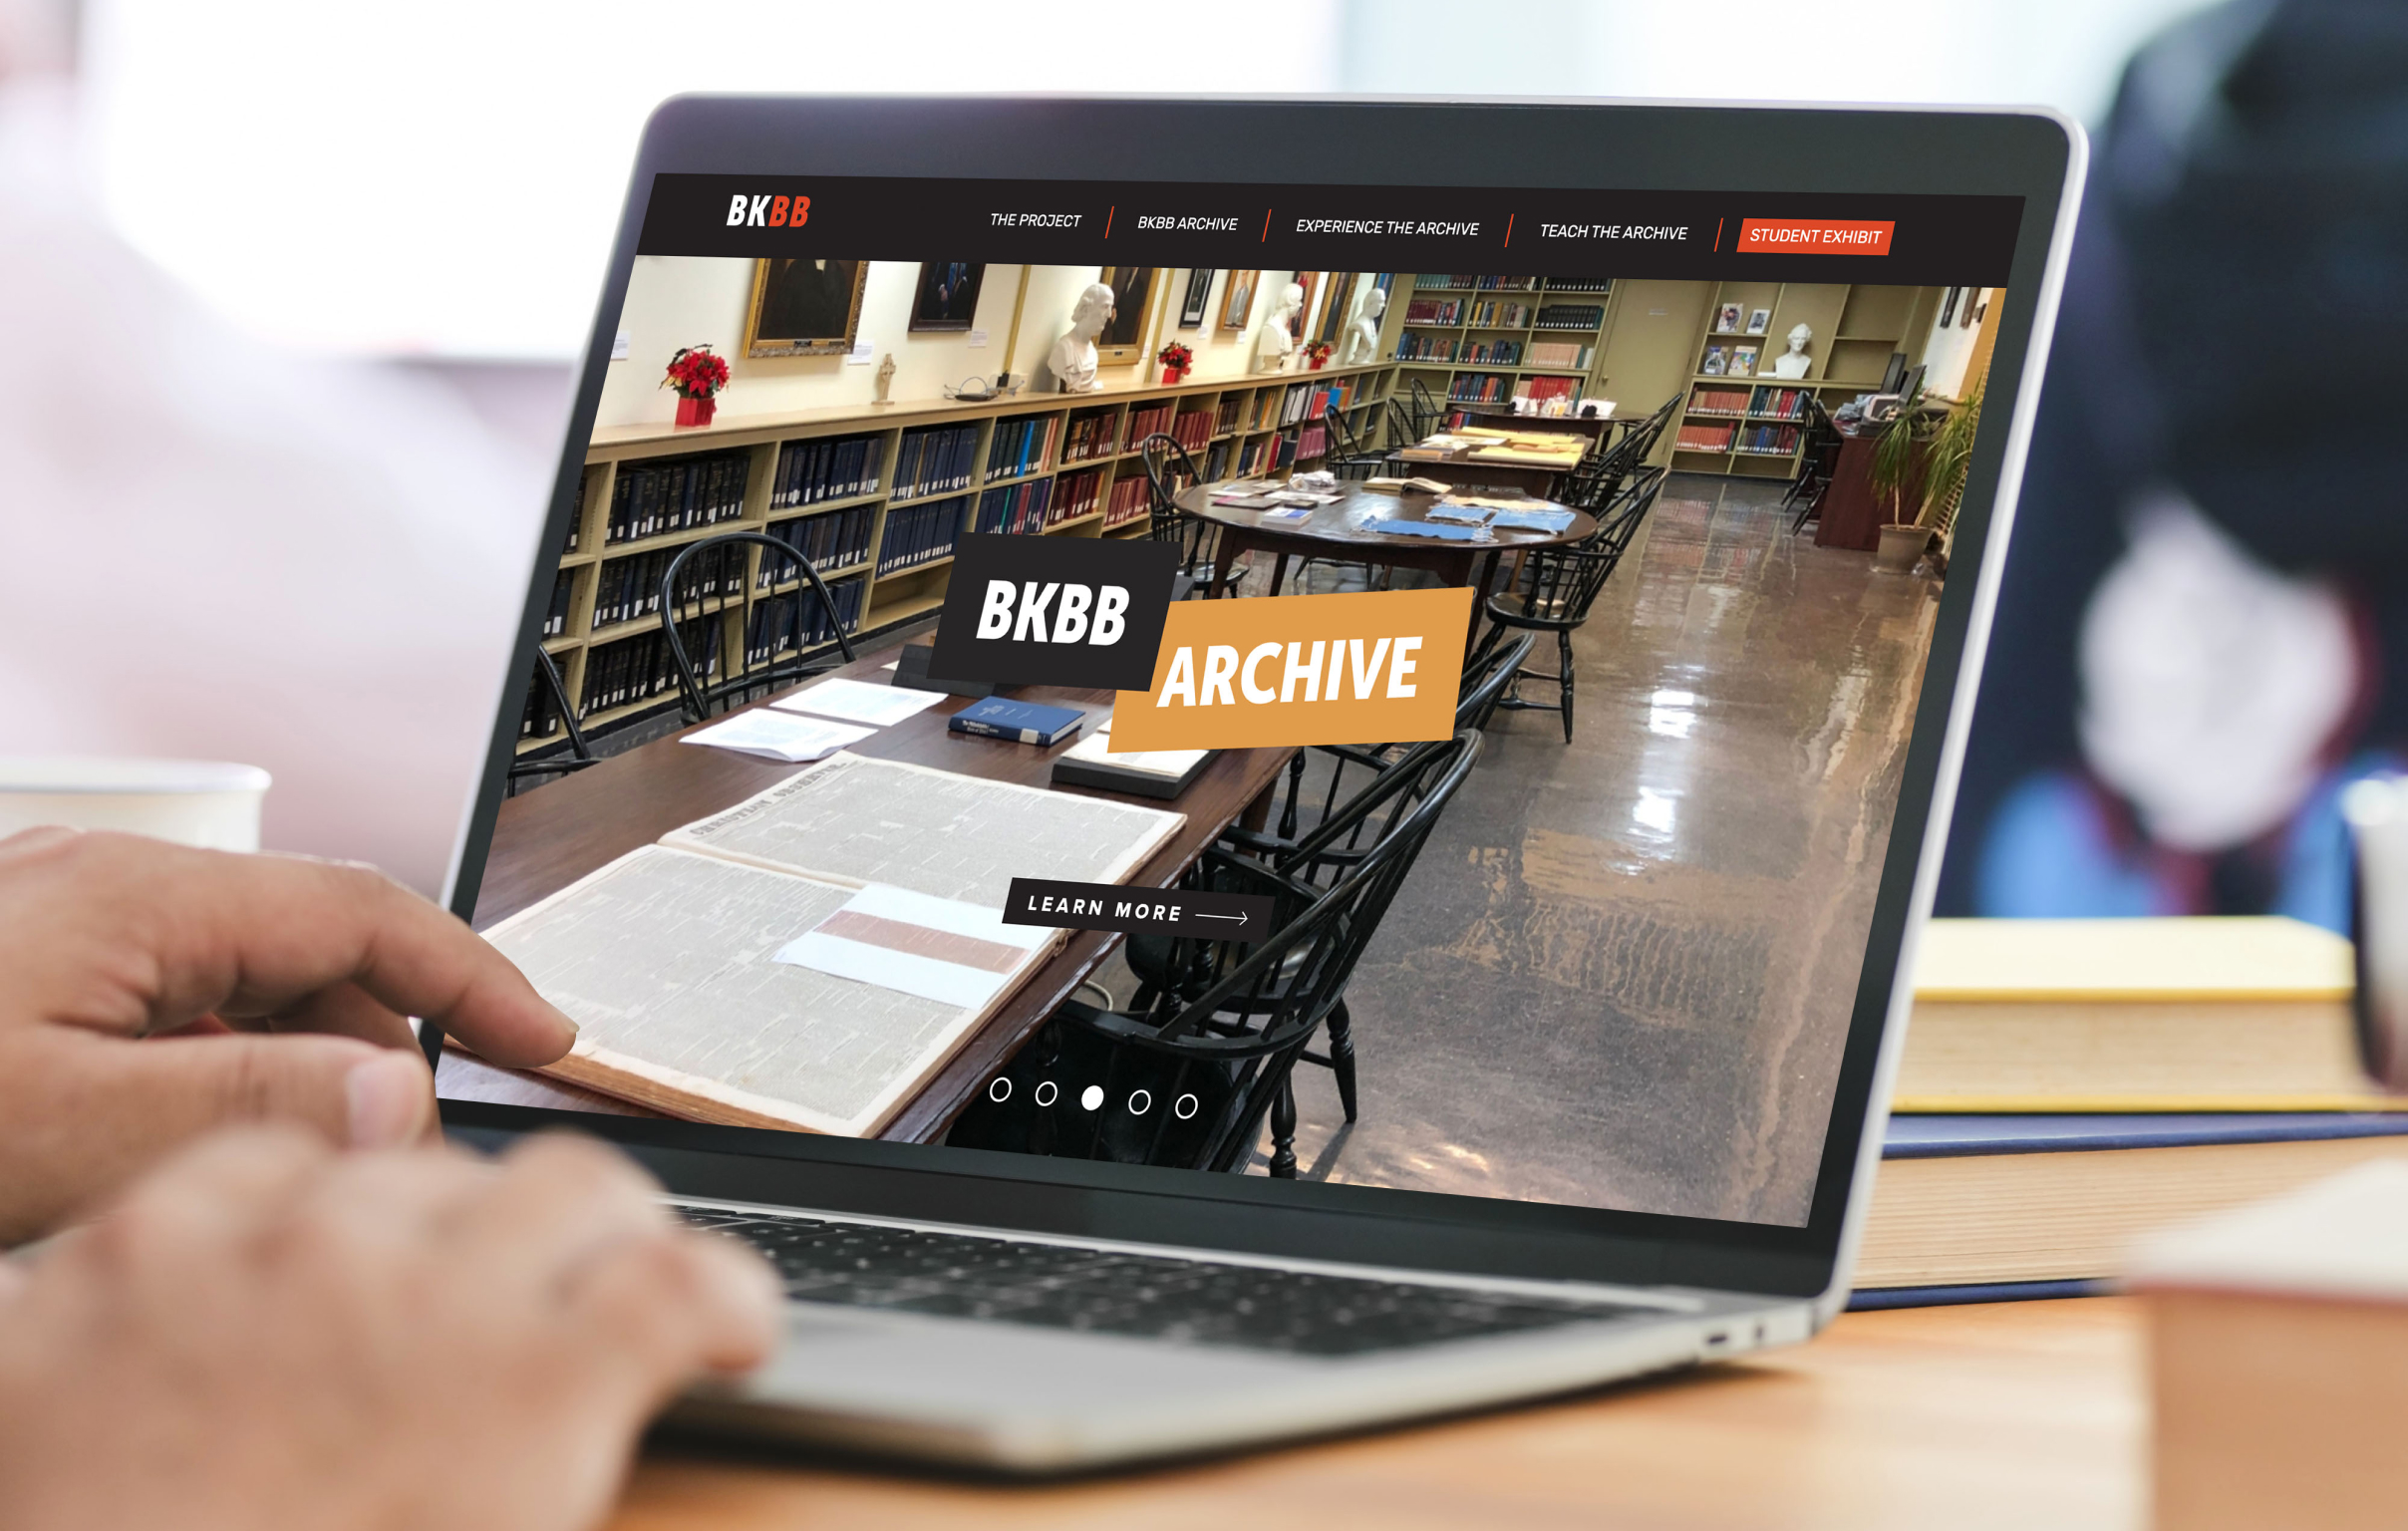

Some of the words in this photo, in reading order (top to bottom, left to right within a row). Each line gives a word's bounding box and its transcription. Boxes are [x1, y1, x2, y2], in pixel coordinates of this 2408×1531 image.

[727, 194, 811, 227] BKBB
[991, 212, 1017, 226] THE
[1019, 213, 1082, 227] PROJECT
[1137, 216, 1175, 229] BKBB
[1177, 216, 1239, 231] ARCHIVE
[1296, 218, 1384, 234] EXPERIENCE
[1386, 220, 1414, 234] THE
[1415, 221, 1480, 236] ARCHIVE
[1541, 223, 1590, 238] TEACH
[1592, 224, 1621, 239] THE
[1623, 225, 1688, 240] ARCHIVE
[1750, 228, 1820, 243] STUDENT
[1822, 229, 1883, 244] EXHIBIT
[976, 580, 1129, 645] BKBB
[1156, 636, 1422, 707] ARCHIVE
[1027, 895, 1103, 916] LEARN
[1114, 901, 1182, 922] MORE
